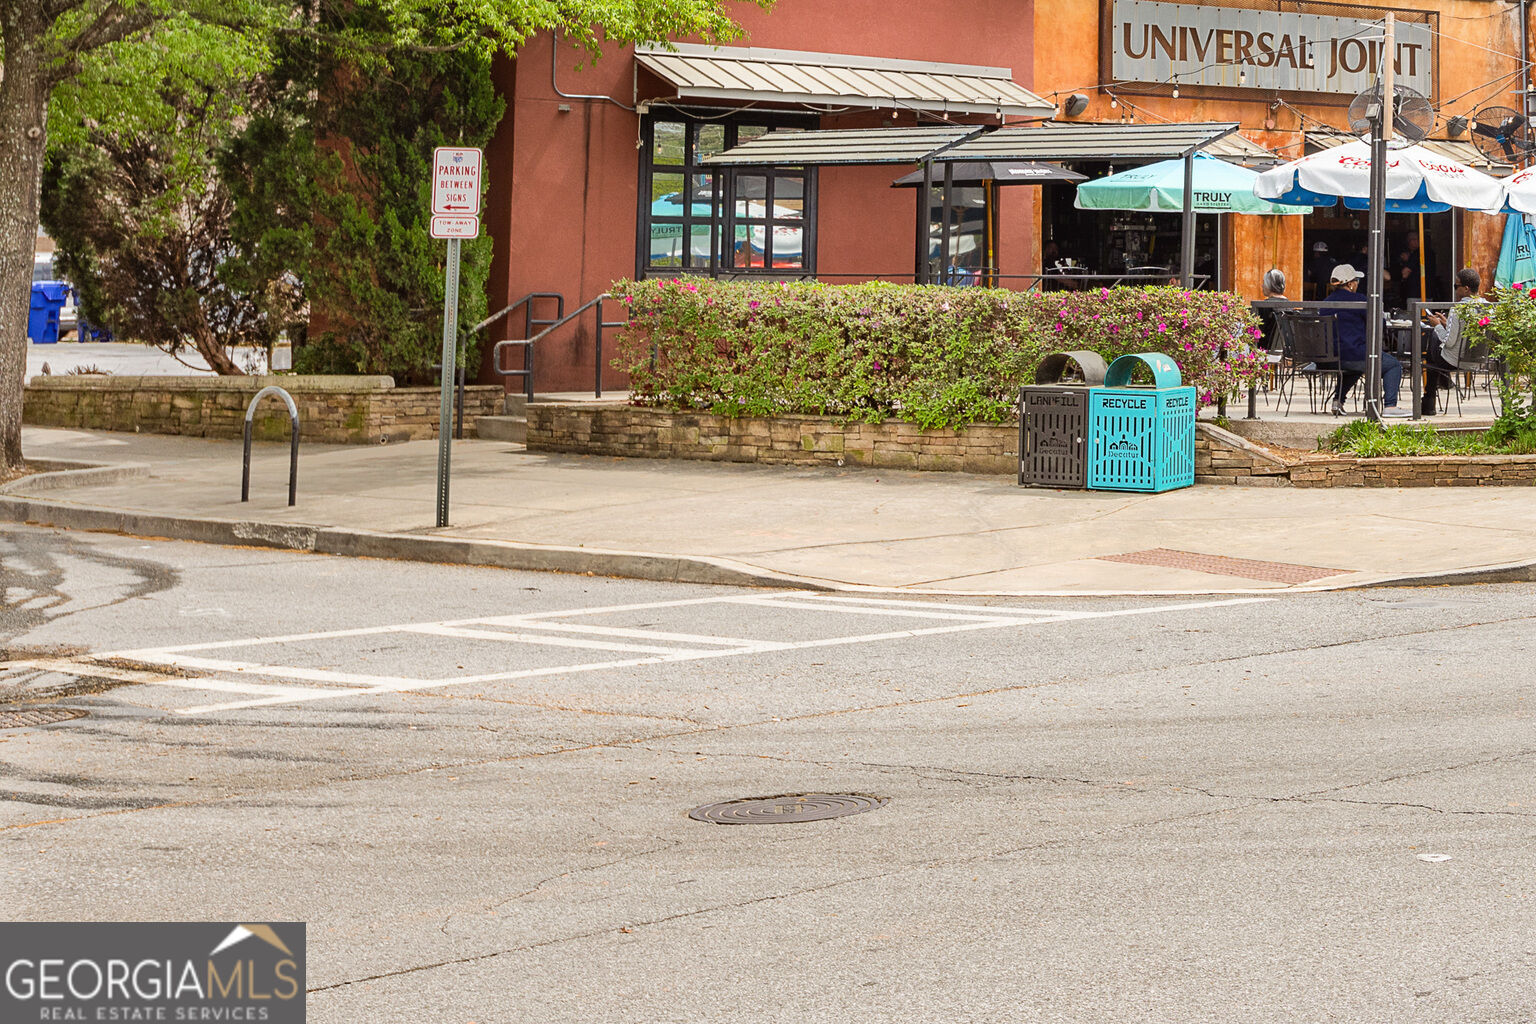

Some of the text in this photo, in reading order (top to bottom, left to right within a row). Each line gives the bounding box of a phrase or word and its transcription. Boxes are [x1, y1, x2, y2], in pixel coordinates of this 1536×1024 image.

[1123, 22, 1315, 71] UNIVERSAL
[439, 165, 476, 176] PARKING
[440, 180, 473, 189] BETWEEN
[446, 193, 467, 202] SIGNS
[1193, 192, 1232, 202] TRULY
[1102, 398, 1147, 410] RECYCLE
[1166, 396, 1189, 408] RECYCLE
[1108, 450, 1139, 459] Decatur
